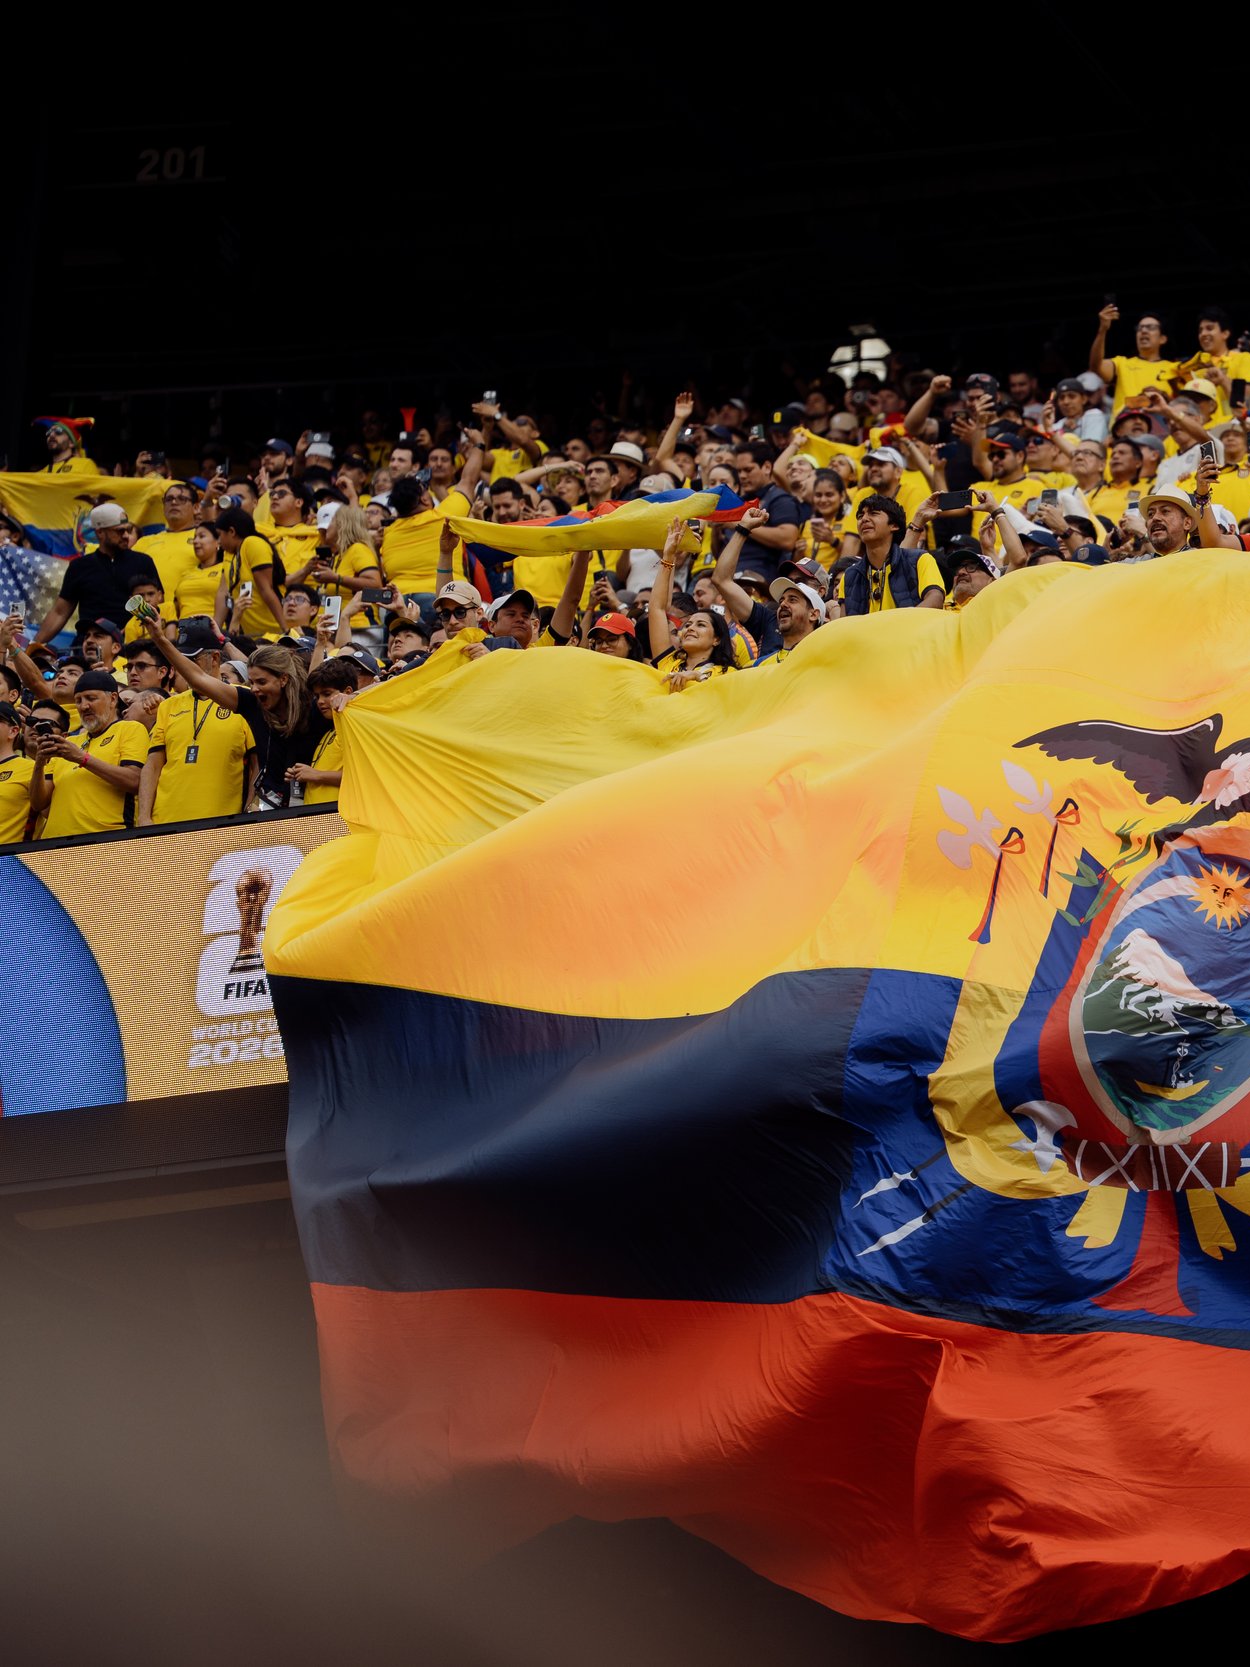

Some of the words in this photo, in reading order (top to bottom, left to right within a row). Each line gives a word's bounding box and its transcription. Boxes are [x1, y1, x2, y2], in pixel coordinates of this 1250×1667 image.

[136, 146, 206, 182] 201
[223, 979, 267, 1000] FIFA
[192, 1021, 256, 1040] WORLD
[257, 1018, 279, 1034] CU
[188, 1035, 285, 1067] 2026
